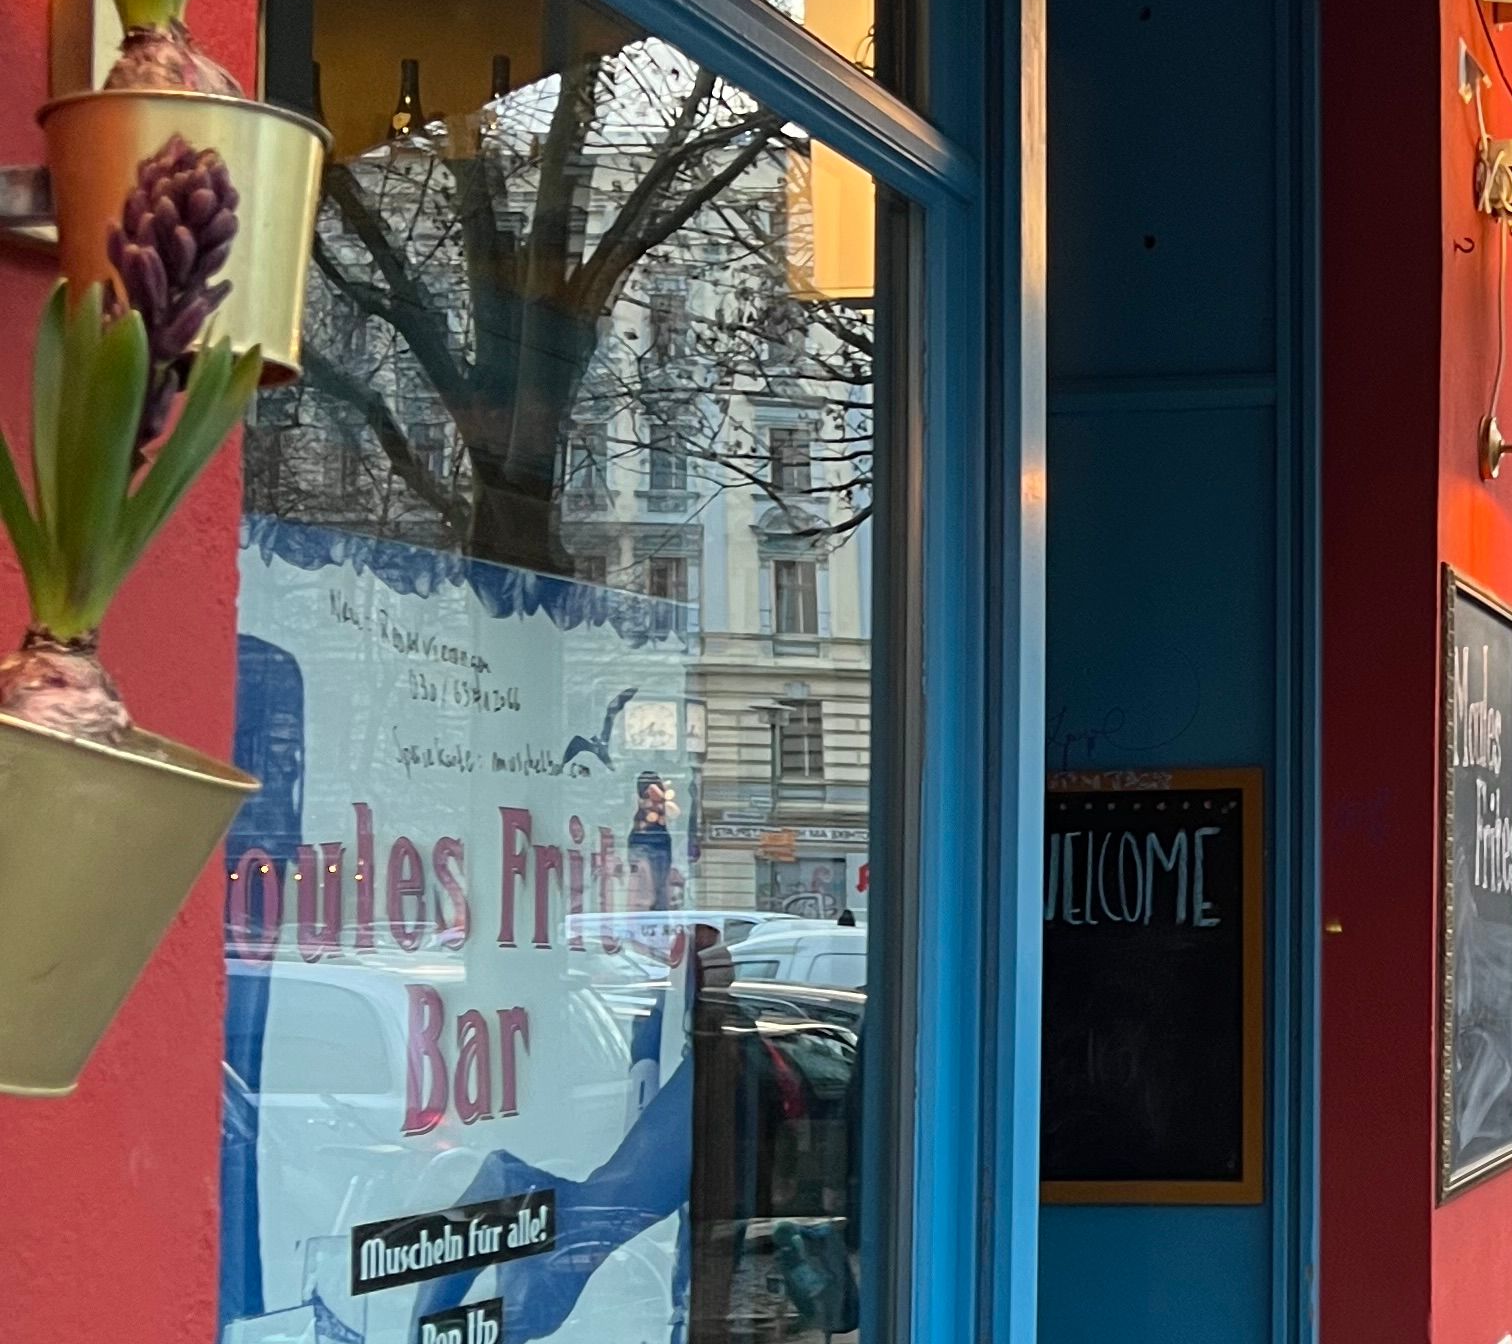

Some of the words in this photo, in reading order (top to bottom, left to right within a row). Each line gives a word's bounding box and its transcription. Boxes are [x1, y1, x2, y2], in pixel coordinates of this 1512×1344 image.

[228, 801, 471, 964] oules
[400, 983, 530, 1136] Bar
[360, 1224, 464, 1280] Muscheln
[469, 1218, 502, 1256] für
[507, 1205, 549, 1249] alle!
